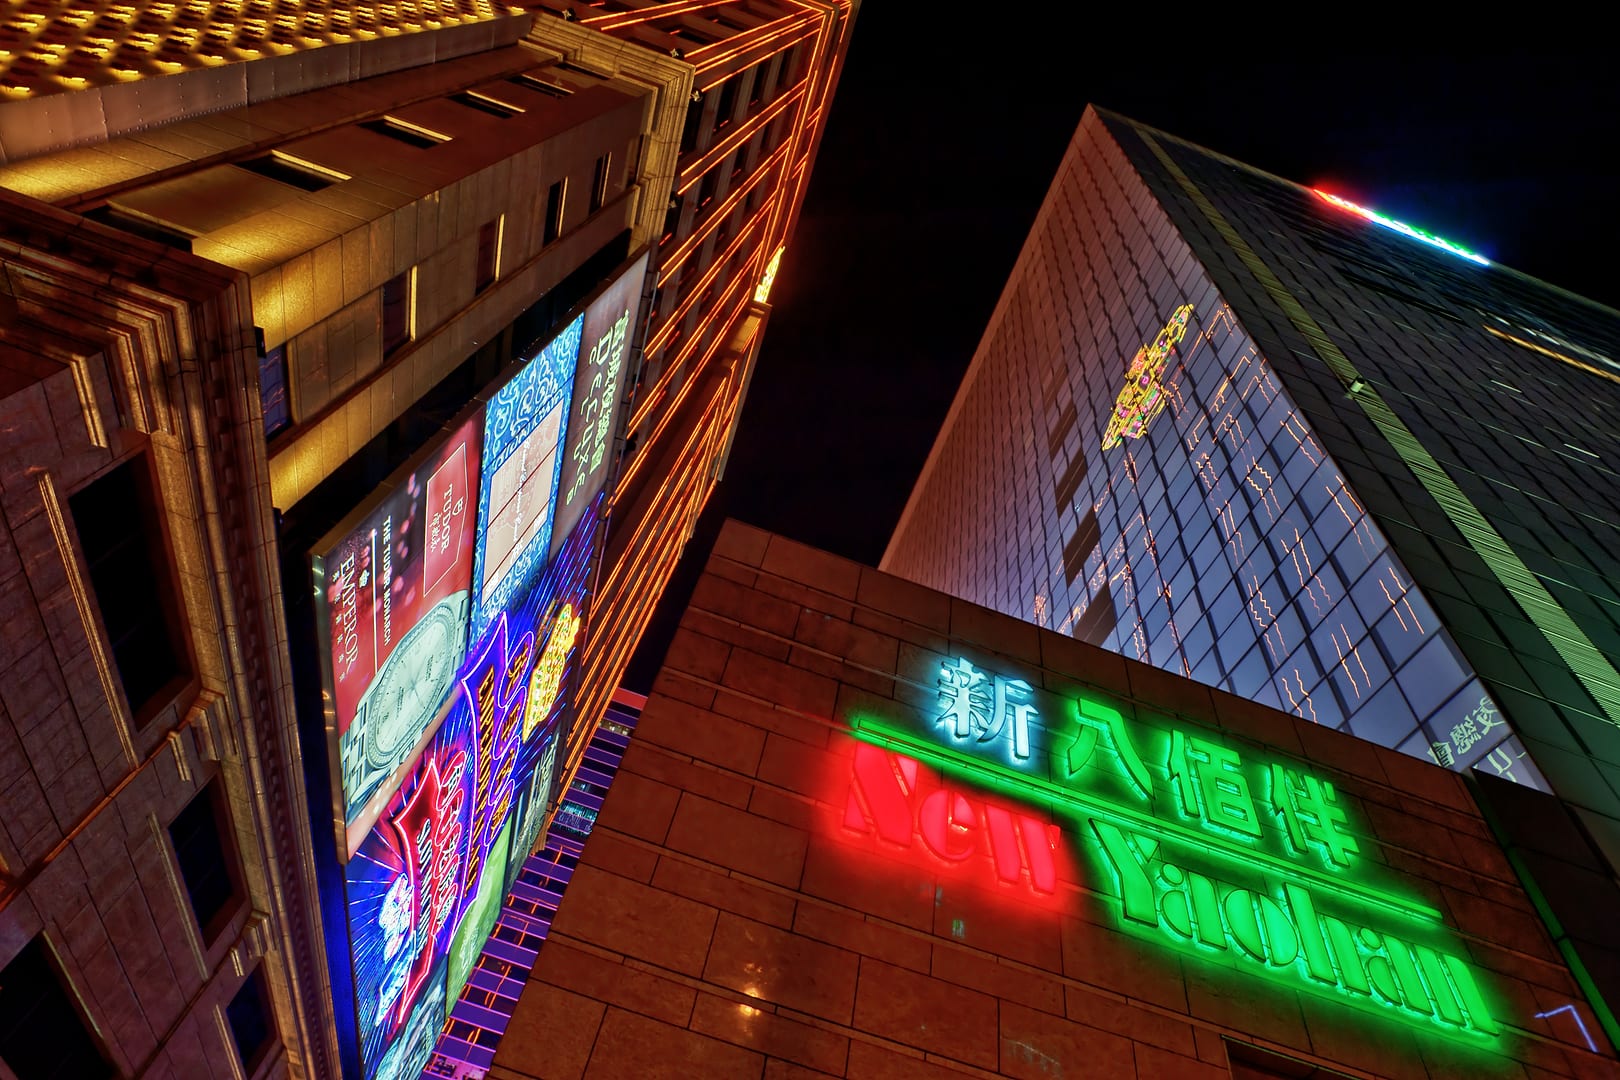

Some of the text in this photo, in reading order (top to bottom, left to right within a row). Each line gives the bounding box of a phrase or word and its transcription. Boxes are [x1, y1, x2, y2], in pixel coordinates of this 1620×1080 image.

[382, 515, 392, 647] THE TUDOR MONARCH
[440, 482, 453, 555] TUDOR
[340, 551, 360, 675] EMPEROR
[464, 664, 494, 899] EMPEROR PALACE
[415, 817, 433, 960] SLOT MACHINE
[843, 741, 1500, 1037] New Yaohan
